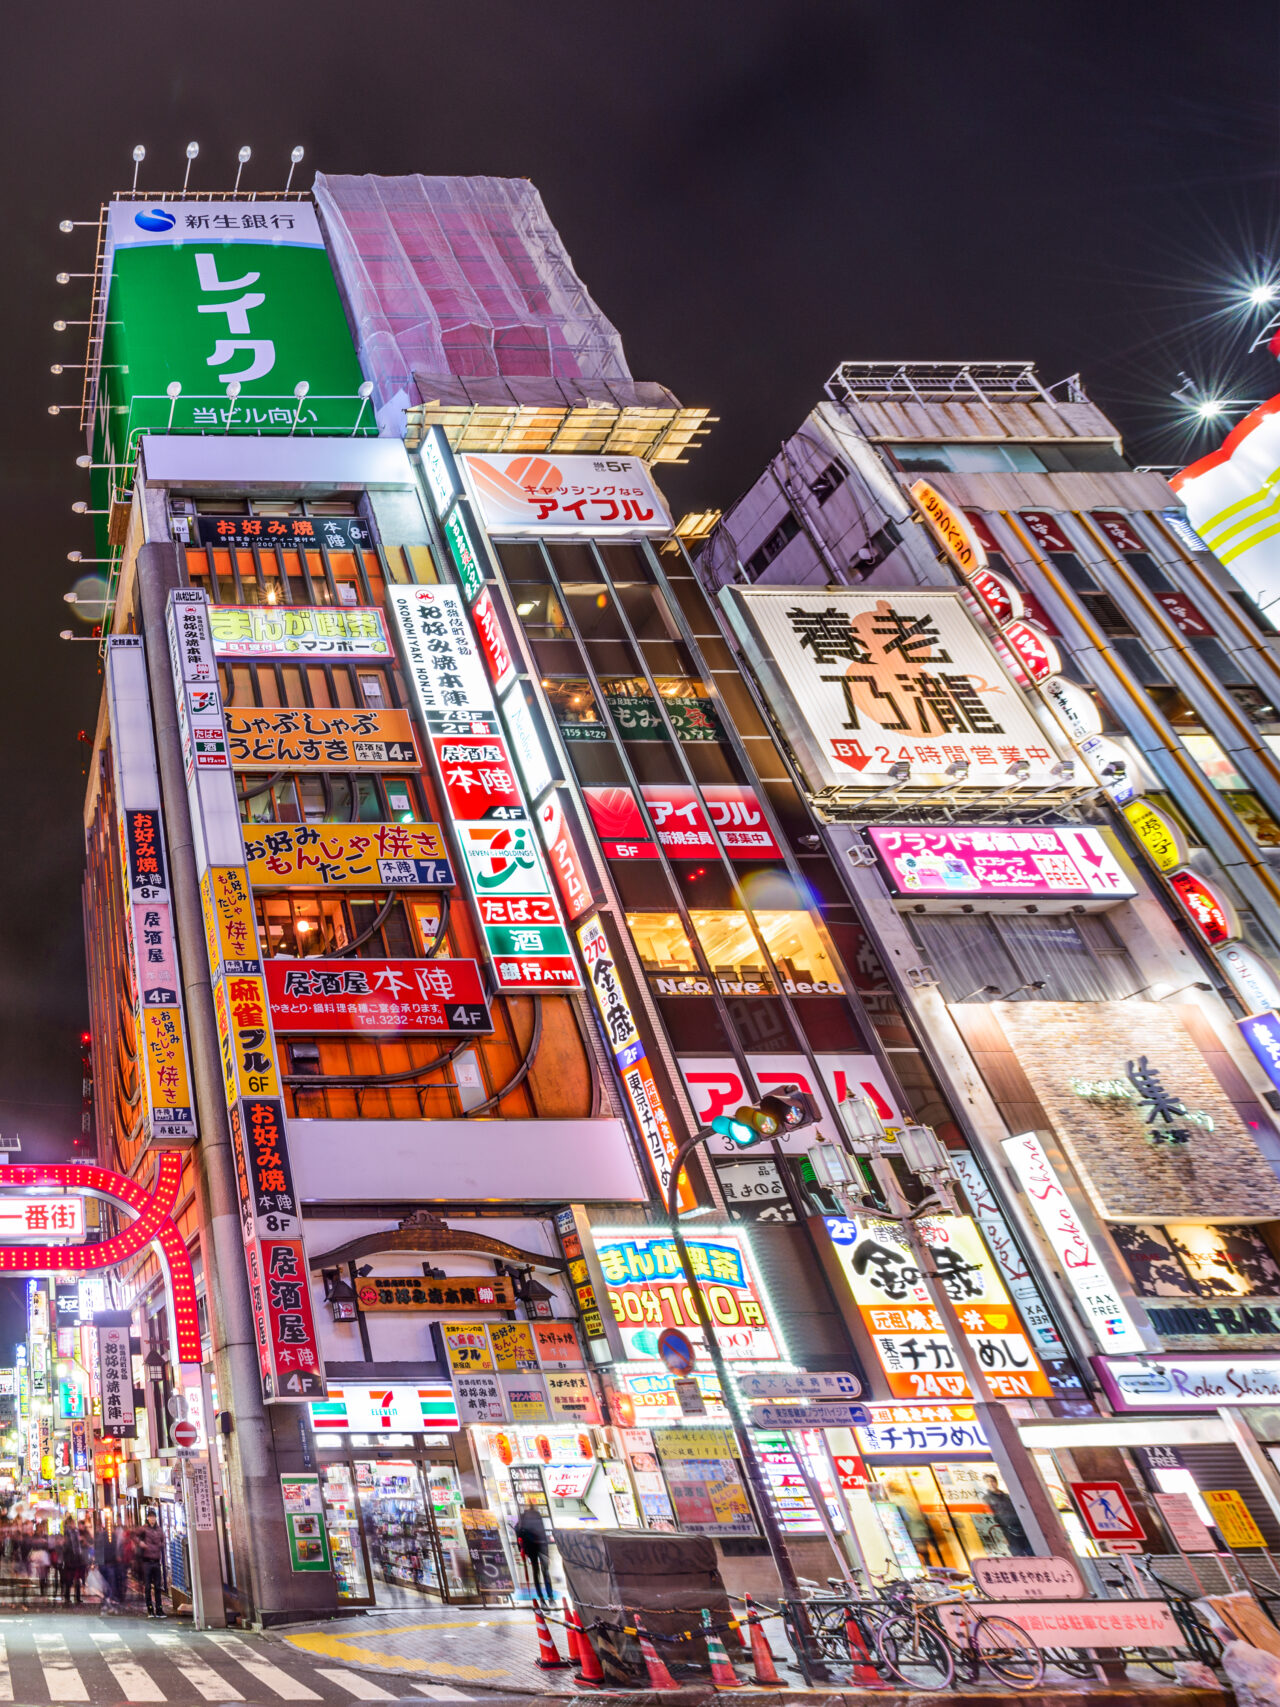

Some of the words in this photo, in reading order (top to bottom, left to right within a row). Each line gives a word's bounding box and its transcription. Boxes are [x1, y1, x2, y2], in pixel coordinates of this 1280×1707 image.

[184, 212, 297, 231] 新生銀行
[194, 252, 277, 384] レイク
[192, 407, 319, 425] 当ビル向い
[606, 461, 633, 473] 5F
[523, 485, 644, 497] キャッシングなら
[528, 497, 654, 521] アイフル
[216, 519, 315, 537] お好み焼
[349, 526, 369, 540] 8F
[211, 609, 380, 641] まんが喫茶
[785, 600, 954, 666] 養老
[301, 638, 371, 653] マンボー
[396, 598, 423, 663] OKONOMIYAKI
[416, 667, 437, 706] HONJIN
[480, 612, 509, 677] アイフル
[819, 672, 1007, 735] 乃瀧
[224, 711, 379, 736] しゃぶしゃぶ
[440, 723, 470, 735] 2F
[194, 729, 224, 740] たばこ
[203, 741, 217, 753] 酒
[226, 736, 351, 761] うどんすき
[387, 742, 415, 762] 4F
[440, 744, 505, 763] 居酒屋
[835, 741, 866, 758] B1
[874, 743, 1053, 766] 24時間営業中
[446, 765, 515, 795] 本陣
[491, 806, 522, 820] 4F
[647, 800, 761, 827] アイフル
[131, 812, 159, 874] お好み焼
[244, 826, 321, 861] お好み
[657, 830, 715, 845] 新規会員
[725, 831, 765, 846] 募集中
[878, 830, 1063, 852] ブランド高価買取
[616, 843, 639, 857] 5F
[382, 860, 418, 874] 本陣
[423, 861, 447, 884] 7F
[553, 838, 584, 897] アコム
[1036, 857, 1074, 871] TAX
[135, 873, 164, 886] 本陣
[384, 873, 418, 884] PART2
[1045, 871, 1082, 886] FREE
[1091, 872, 1120, 889] 1F
[139, 887, 160, 899] 8F
[481, 900, 558, 922] たばこ
[573, 894, 587, 912] 3F
[142, 910, 166, 964] 居酒屋
[509, 929, 544, 952] 酒
[583, 940, 608, 965] 270
[244, 960, 258, 973] 7F
[283, 969, 373, 998] 居酒屋
[373, 969, 458, 1001] 本陣
[782, 978, 846, 996] deco
[148, 990, 171, 1004] 4F
[229, 978, 266, 1029] 麻雀
[592, 957, 636, 1046] 金の蔵
[451, 1005, 482, 1025] 4F
[237, 1028, 272, 1075] ブル
[623, 1046, 639, 1065] 2F
[248, 1076, 269, 1093] 6F
[175, 1108, 188, 1120] 7F
[160, 1126, 188, 1135] 小松ビル
[250, 1102, 287, 1193] お好み焼
[257, 1193, 294, 1211] 本陣
[265, 1214, 292, 1232] 8F
[826, 1218, 858, 1240] 2F
[597, 1244, 741, 1283] まんが喫茶
[269, 1245, 311, 1346] 居酒屋
[1086, 1295, 1118, 1306] TAX
[1092, 1304, 1121, 1318] FREE
[278, 1347, 315, 1368] 本陣
[285, 1373, 314, 1395] 4F
[767, 1377, 835, 1389] 大久保病院
[368, 1390, 394, 1428] 7
[881, 1424, 991, 1450] チカラめし
[1144, 1446, 1172, 1457] TAX
[1148, 1456, 1180, 1467] FREE
[982, 1569, 1076, 1586] 違法駐車をやめましょう
